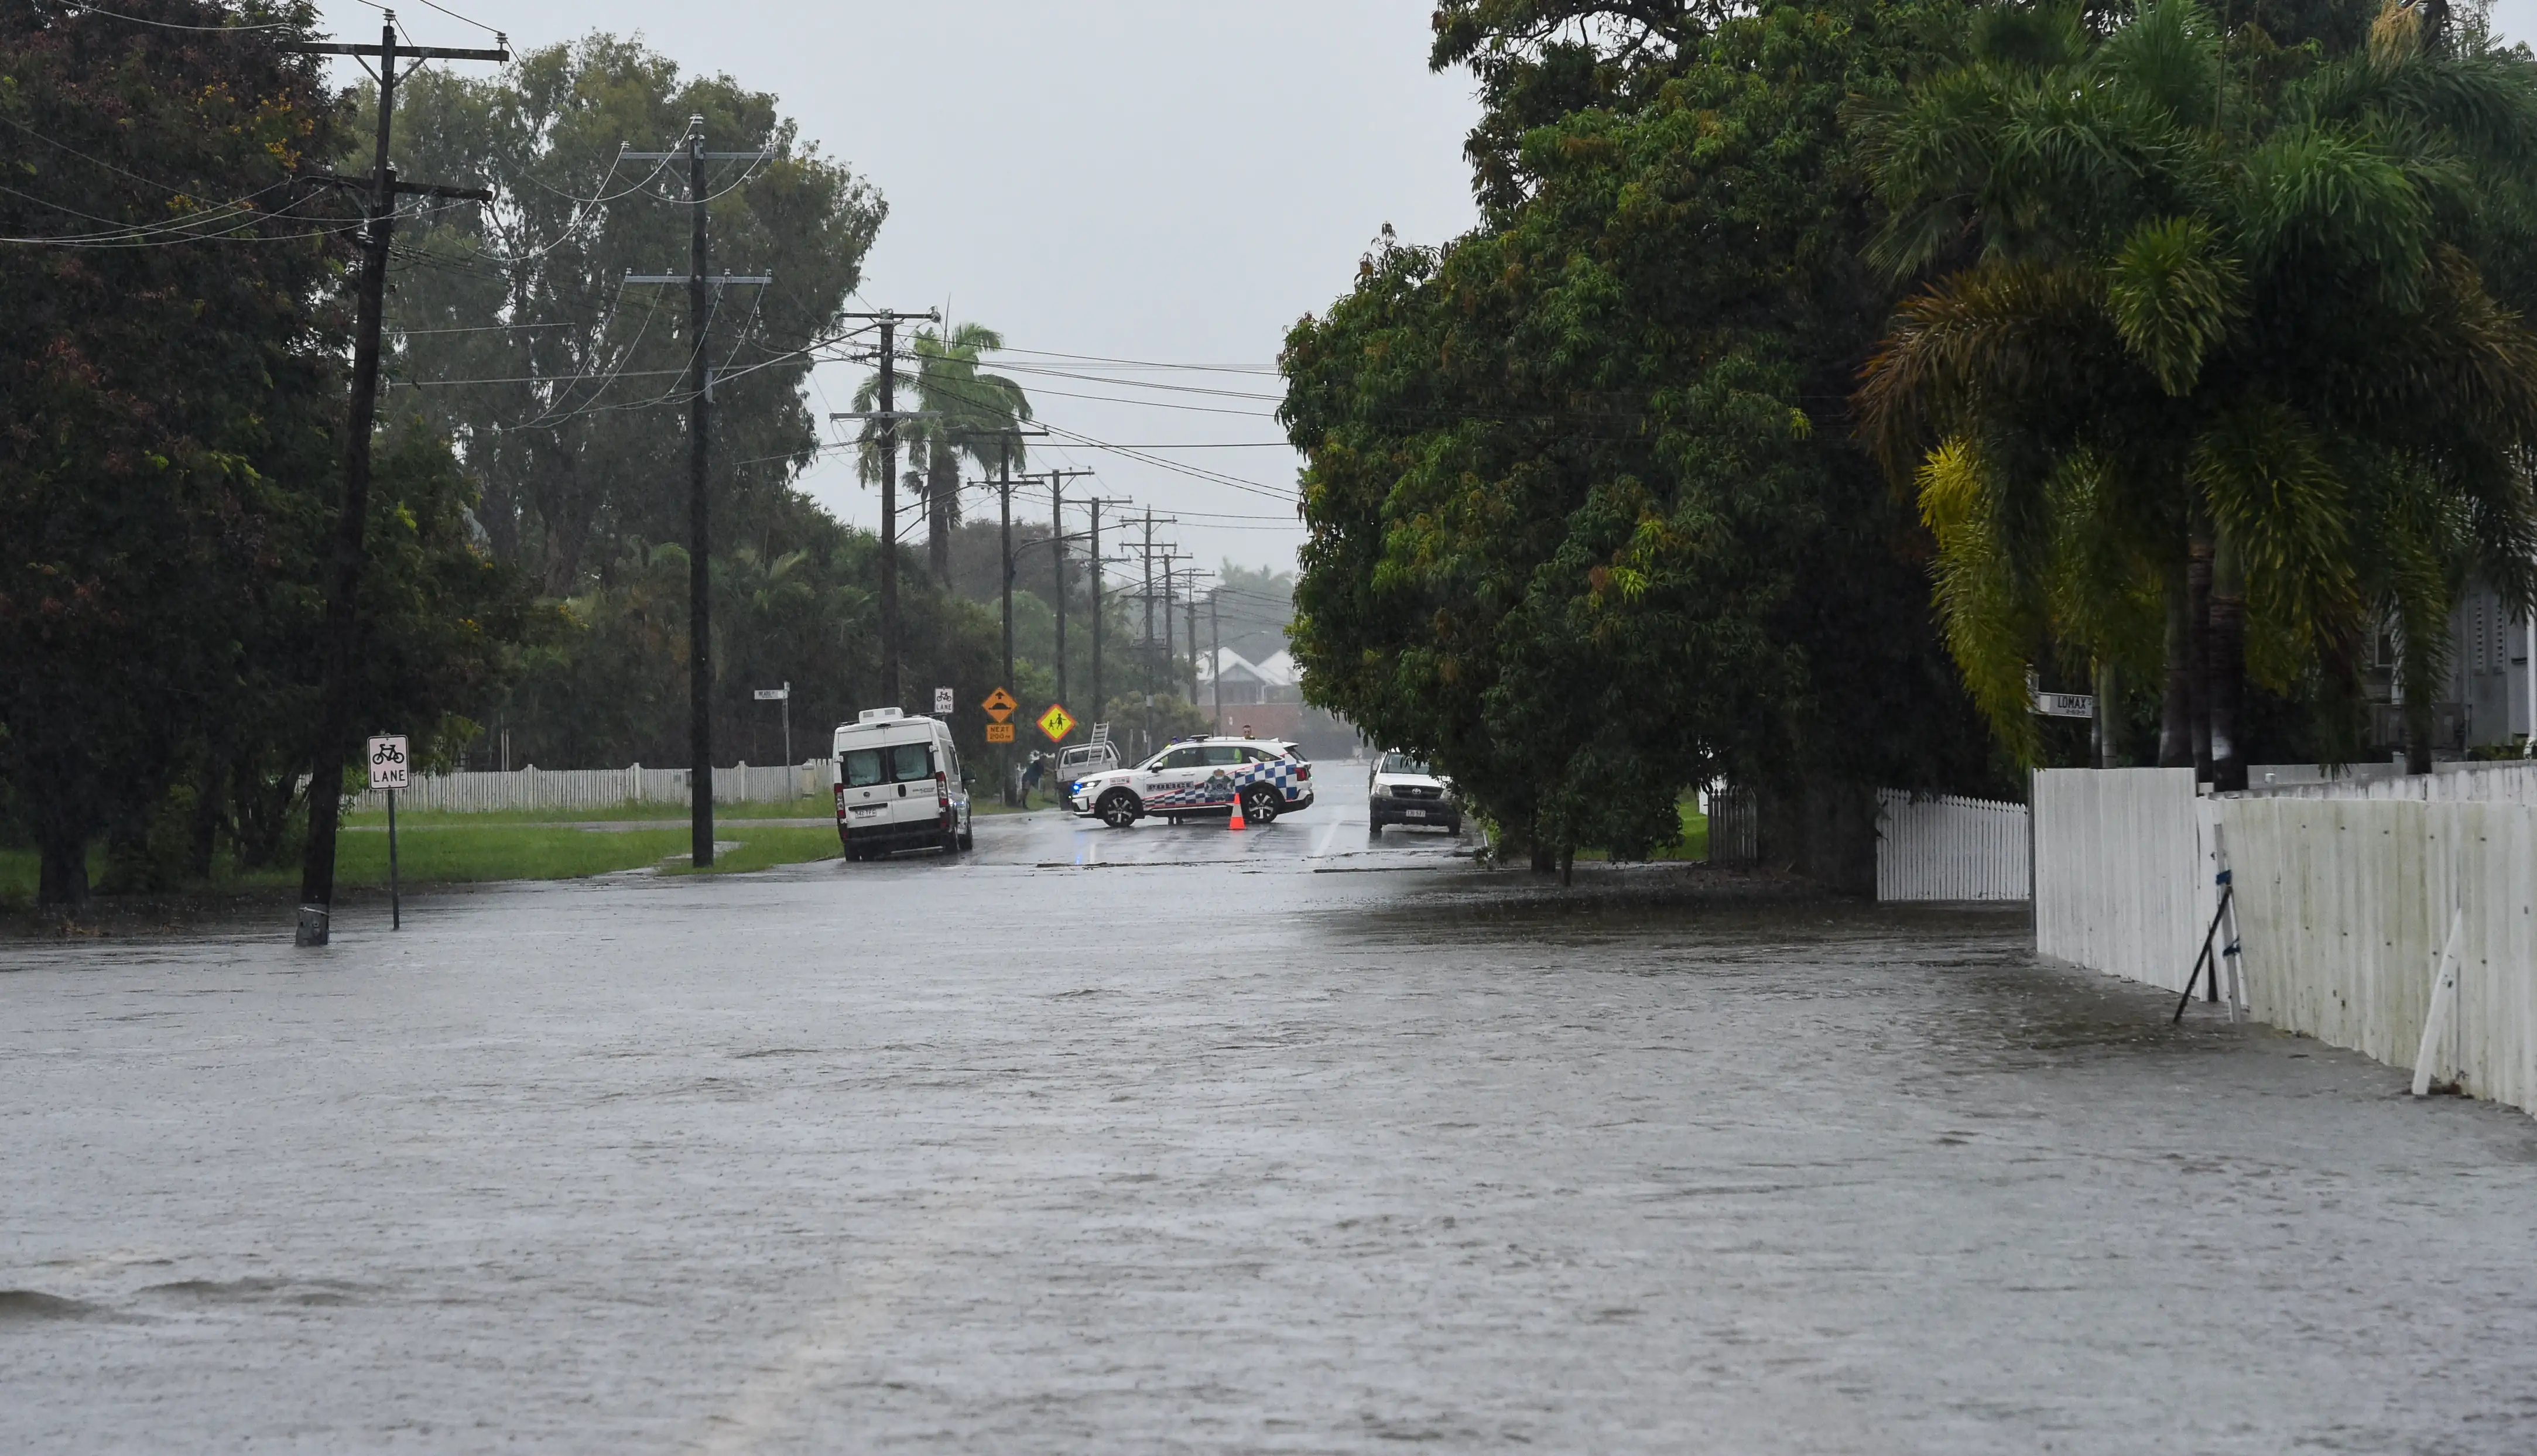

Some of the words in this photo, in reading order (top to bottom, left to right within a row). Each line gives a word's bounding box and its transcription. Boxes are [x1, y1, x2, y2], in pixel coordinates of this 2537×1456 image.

[2057, 696, 2086, 709] LOMAX
[373, 769, 406, 783] LANE
[1148, 782, 1193, 791] POLICE
